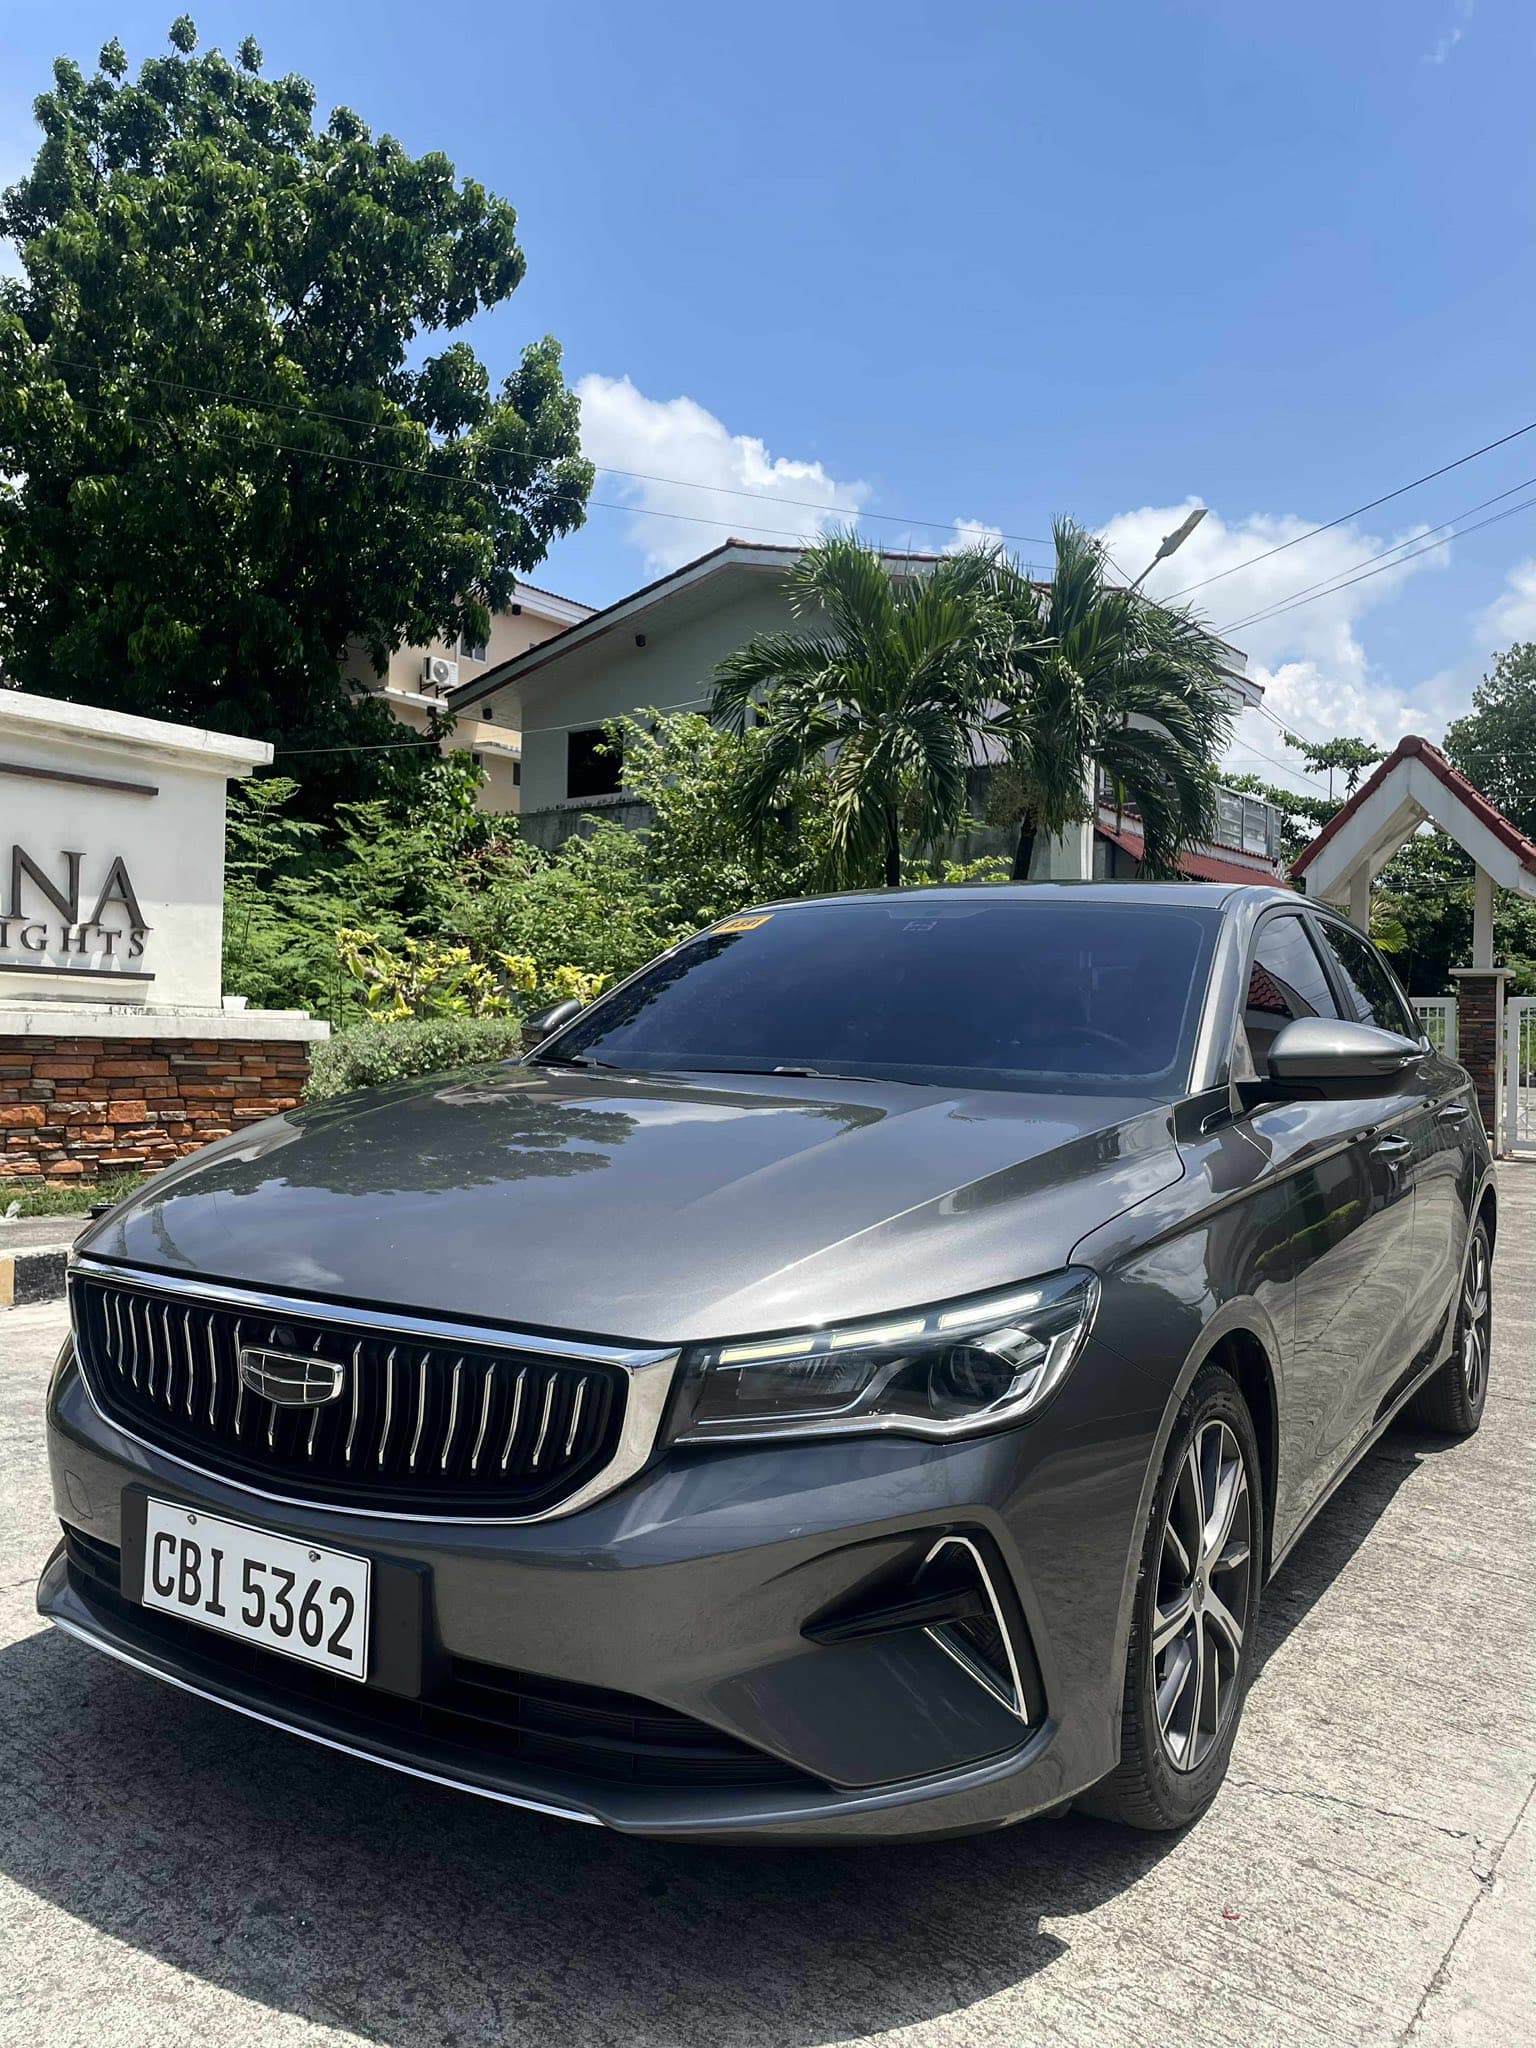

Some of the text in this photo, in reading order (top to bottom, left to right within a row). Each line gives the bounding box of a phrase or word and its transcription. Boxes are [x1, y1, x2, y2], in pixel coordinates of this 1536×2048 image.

[0, 845, 153, 930] NA
[0, 922, 144, 959] IGHTS
[152, 1531, 355, 1660] CBI 5362
